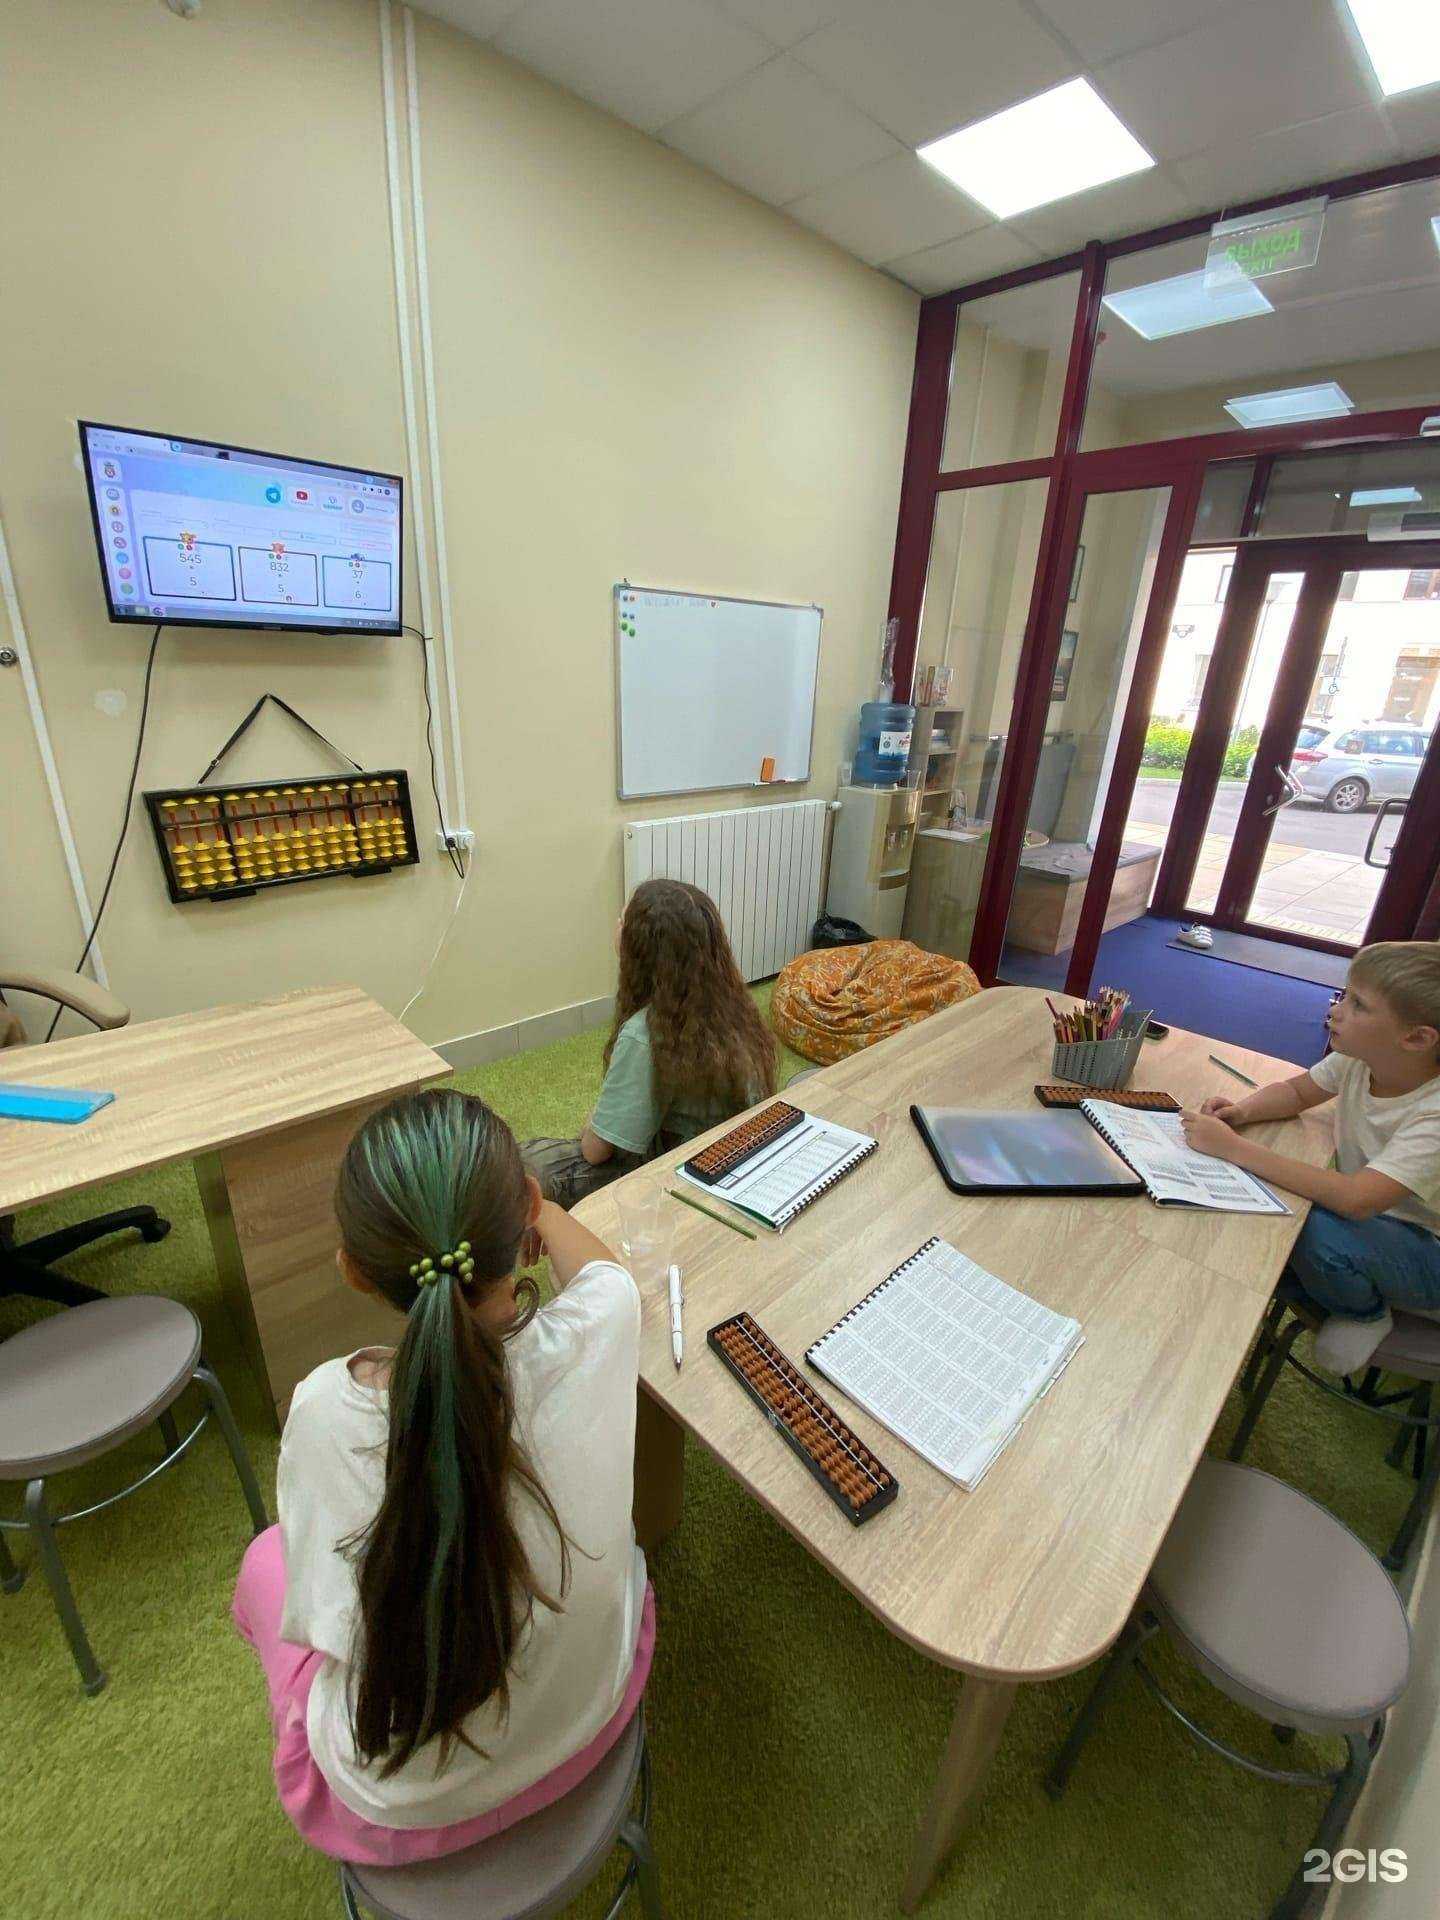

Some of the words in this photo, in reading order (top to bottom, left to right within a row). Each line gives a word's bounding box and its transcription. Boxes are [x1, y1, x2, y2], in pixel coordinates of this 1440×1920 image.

[179, 553, 202, 564] 545
[270, 561, 289, 573] 832
[352, 569, 364, 579] 37
[189, 576, 198, 586] 5
[278, 583, 285, 593] 5
[355, 590, 362, 599] 6
